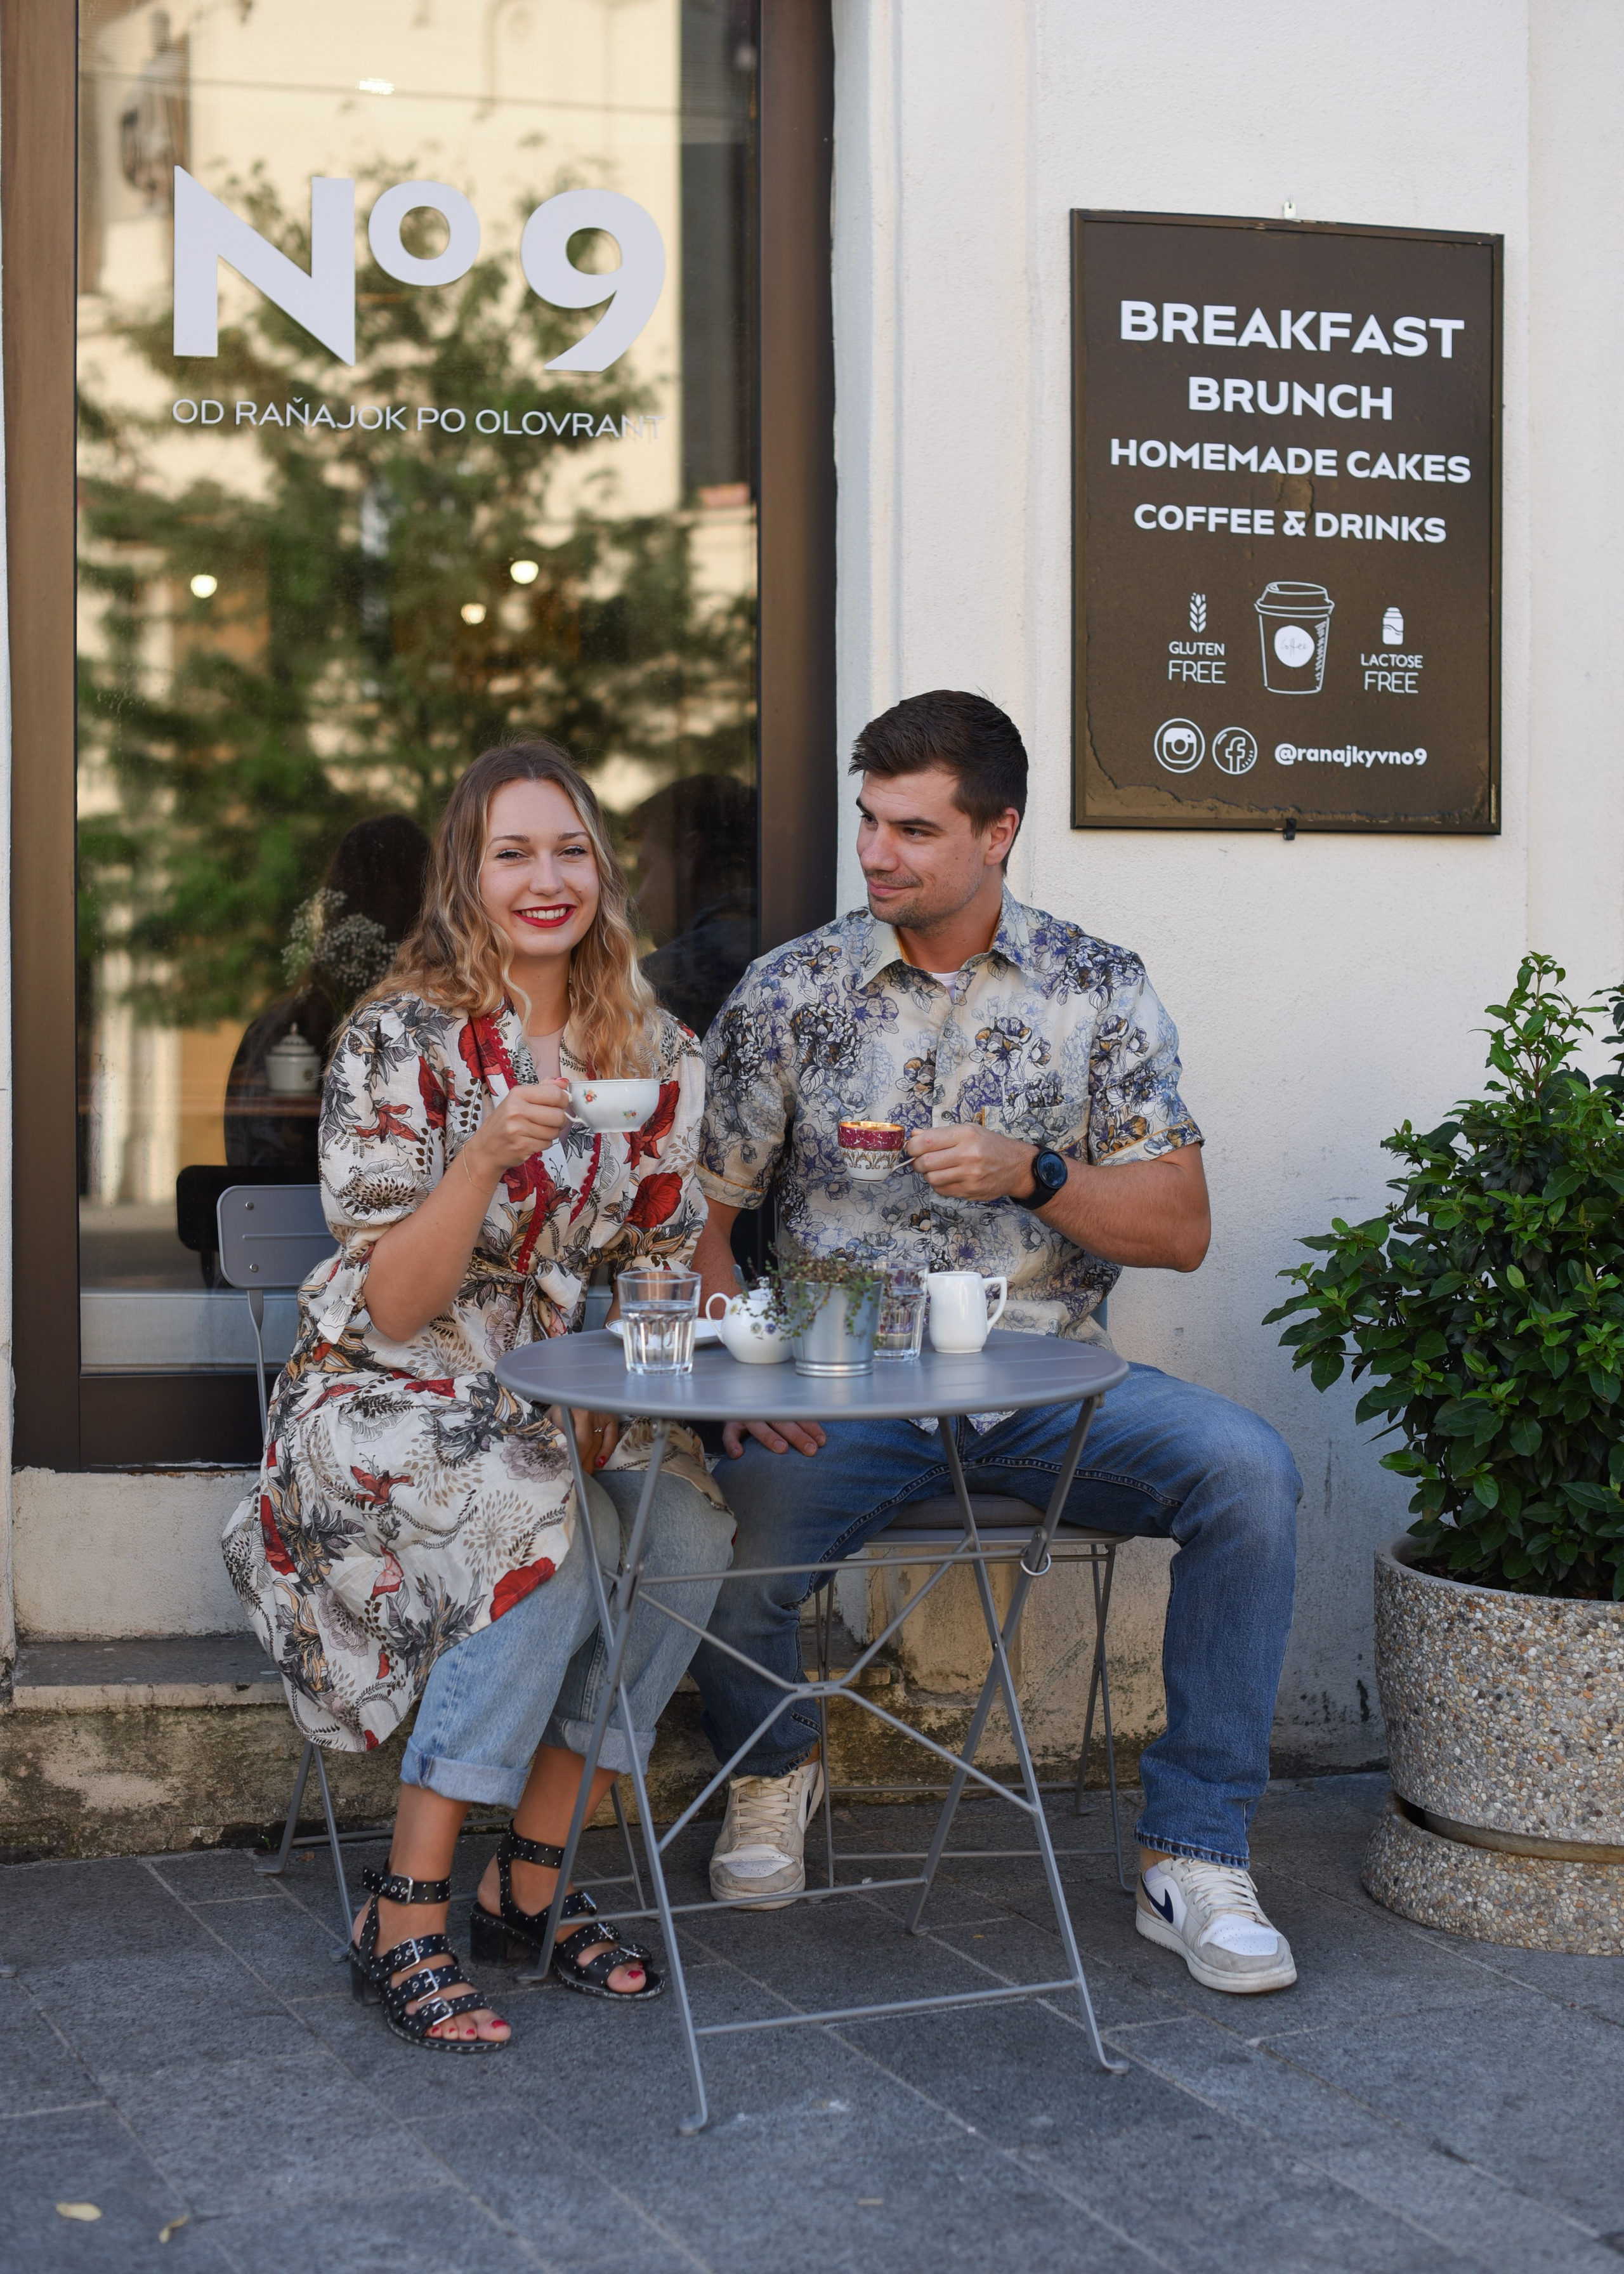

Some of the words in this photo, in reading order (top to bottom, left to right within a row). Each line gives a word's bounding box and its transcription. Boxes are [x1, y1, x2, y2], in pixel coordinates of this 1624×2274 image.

[521, 188, 666, 372] 9
[1120, 300, 1465, 358] BREAKFAST
[172, 398, 224, 424] OD
[235, 396, 408, 432] RAŇAJOK
[416, 407, 466, 433] PO
[476, 408, 665, 440] OLOVRANT
[1189, 376, 1392, 421] BRUNCH
[1110, 438, 1338, 477] HOMEMADE
[1346, 450, 1471, 483] CAKES
[1134, 503, 1275, 536] COFFEE
[1282, 510, 1307, 537] &
[1314, 512, 1446, 543] DRINKS
[1168, 641, 1226, 657] GLUTEN
[1360, 653, 1424, 669] LACTOSE
[1167, 660, 1227, 685] FREE
[1363, 671, 1419, 694] FREE
[1274, 742, 1428, 768] @ranajkyvno9
